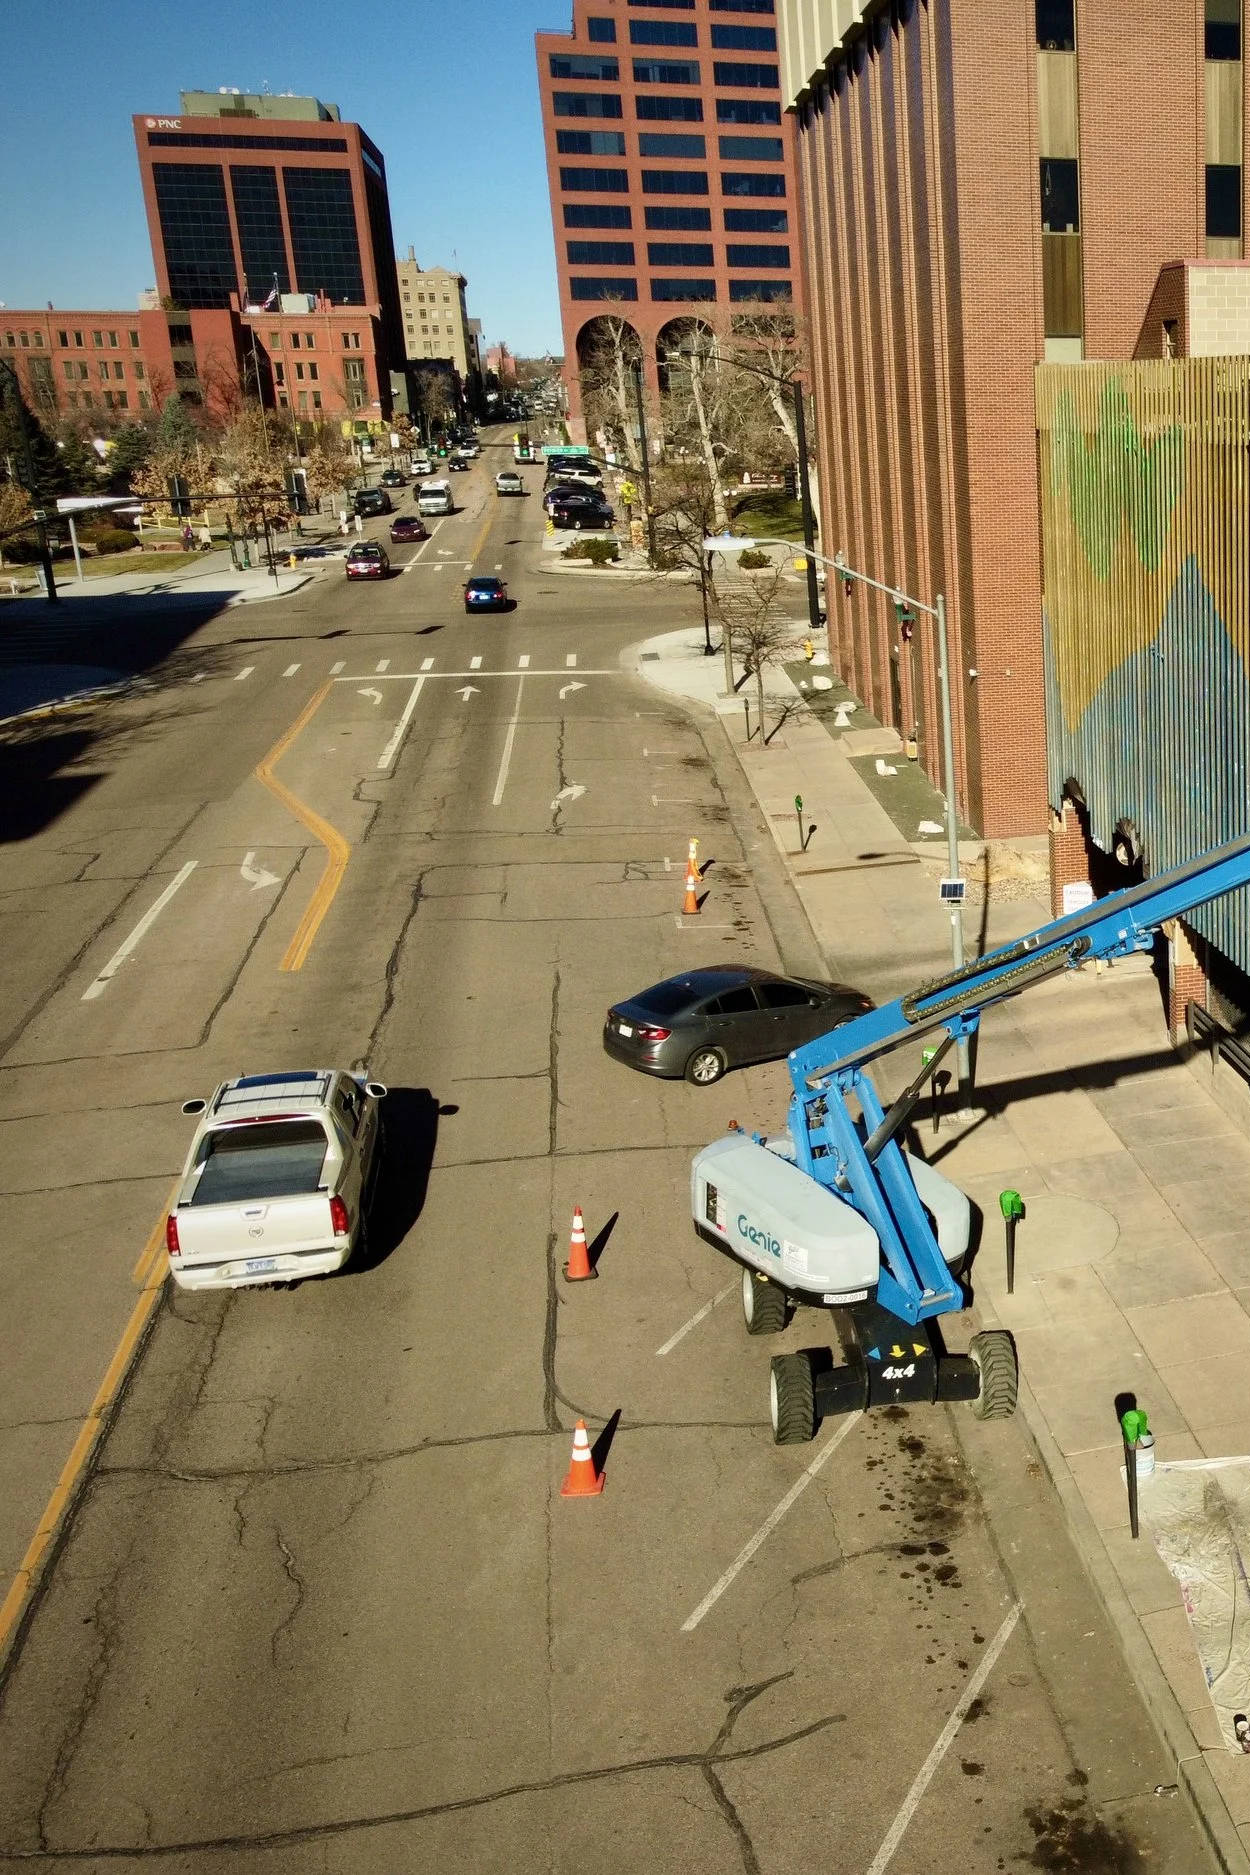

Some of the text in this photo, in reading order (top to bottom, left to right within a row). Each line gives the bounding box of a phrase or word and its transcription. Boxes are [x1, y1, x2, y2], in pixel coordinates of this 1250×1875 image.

[157, 119, 182, 129] PNC
[738, 1214, 781, 1258] Genie
[881, 1363, 915, 1380] 4x4
